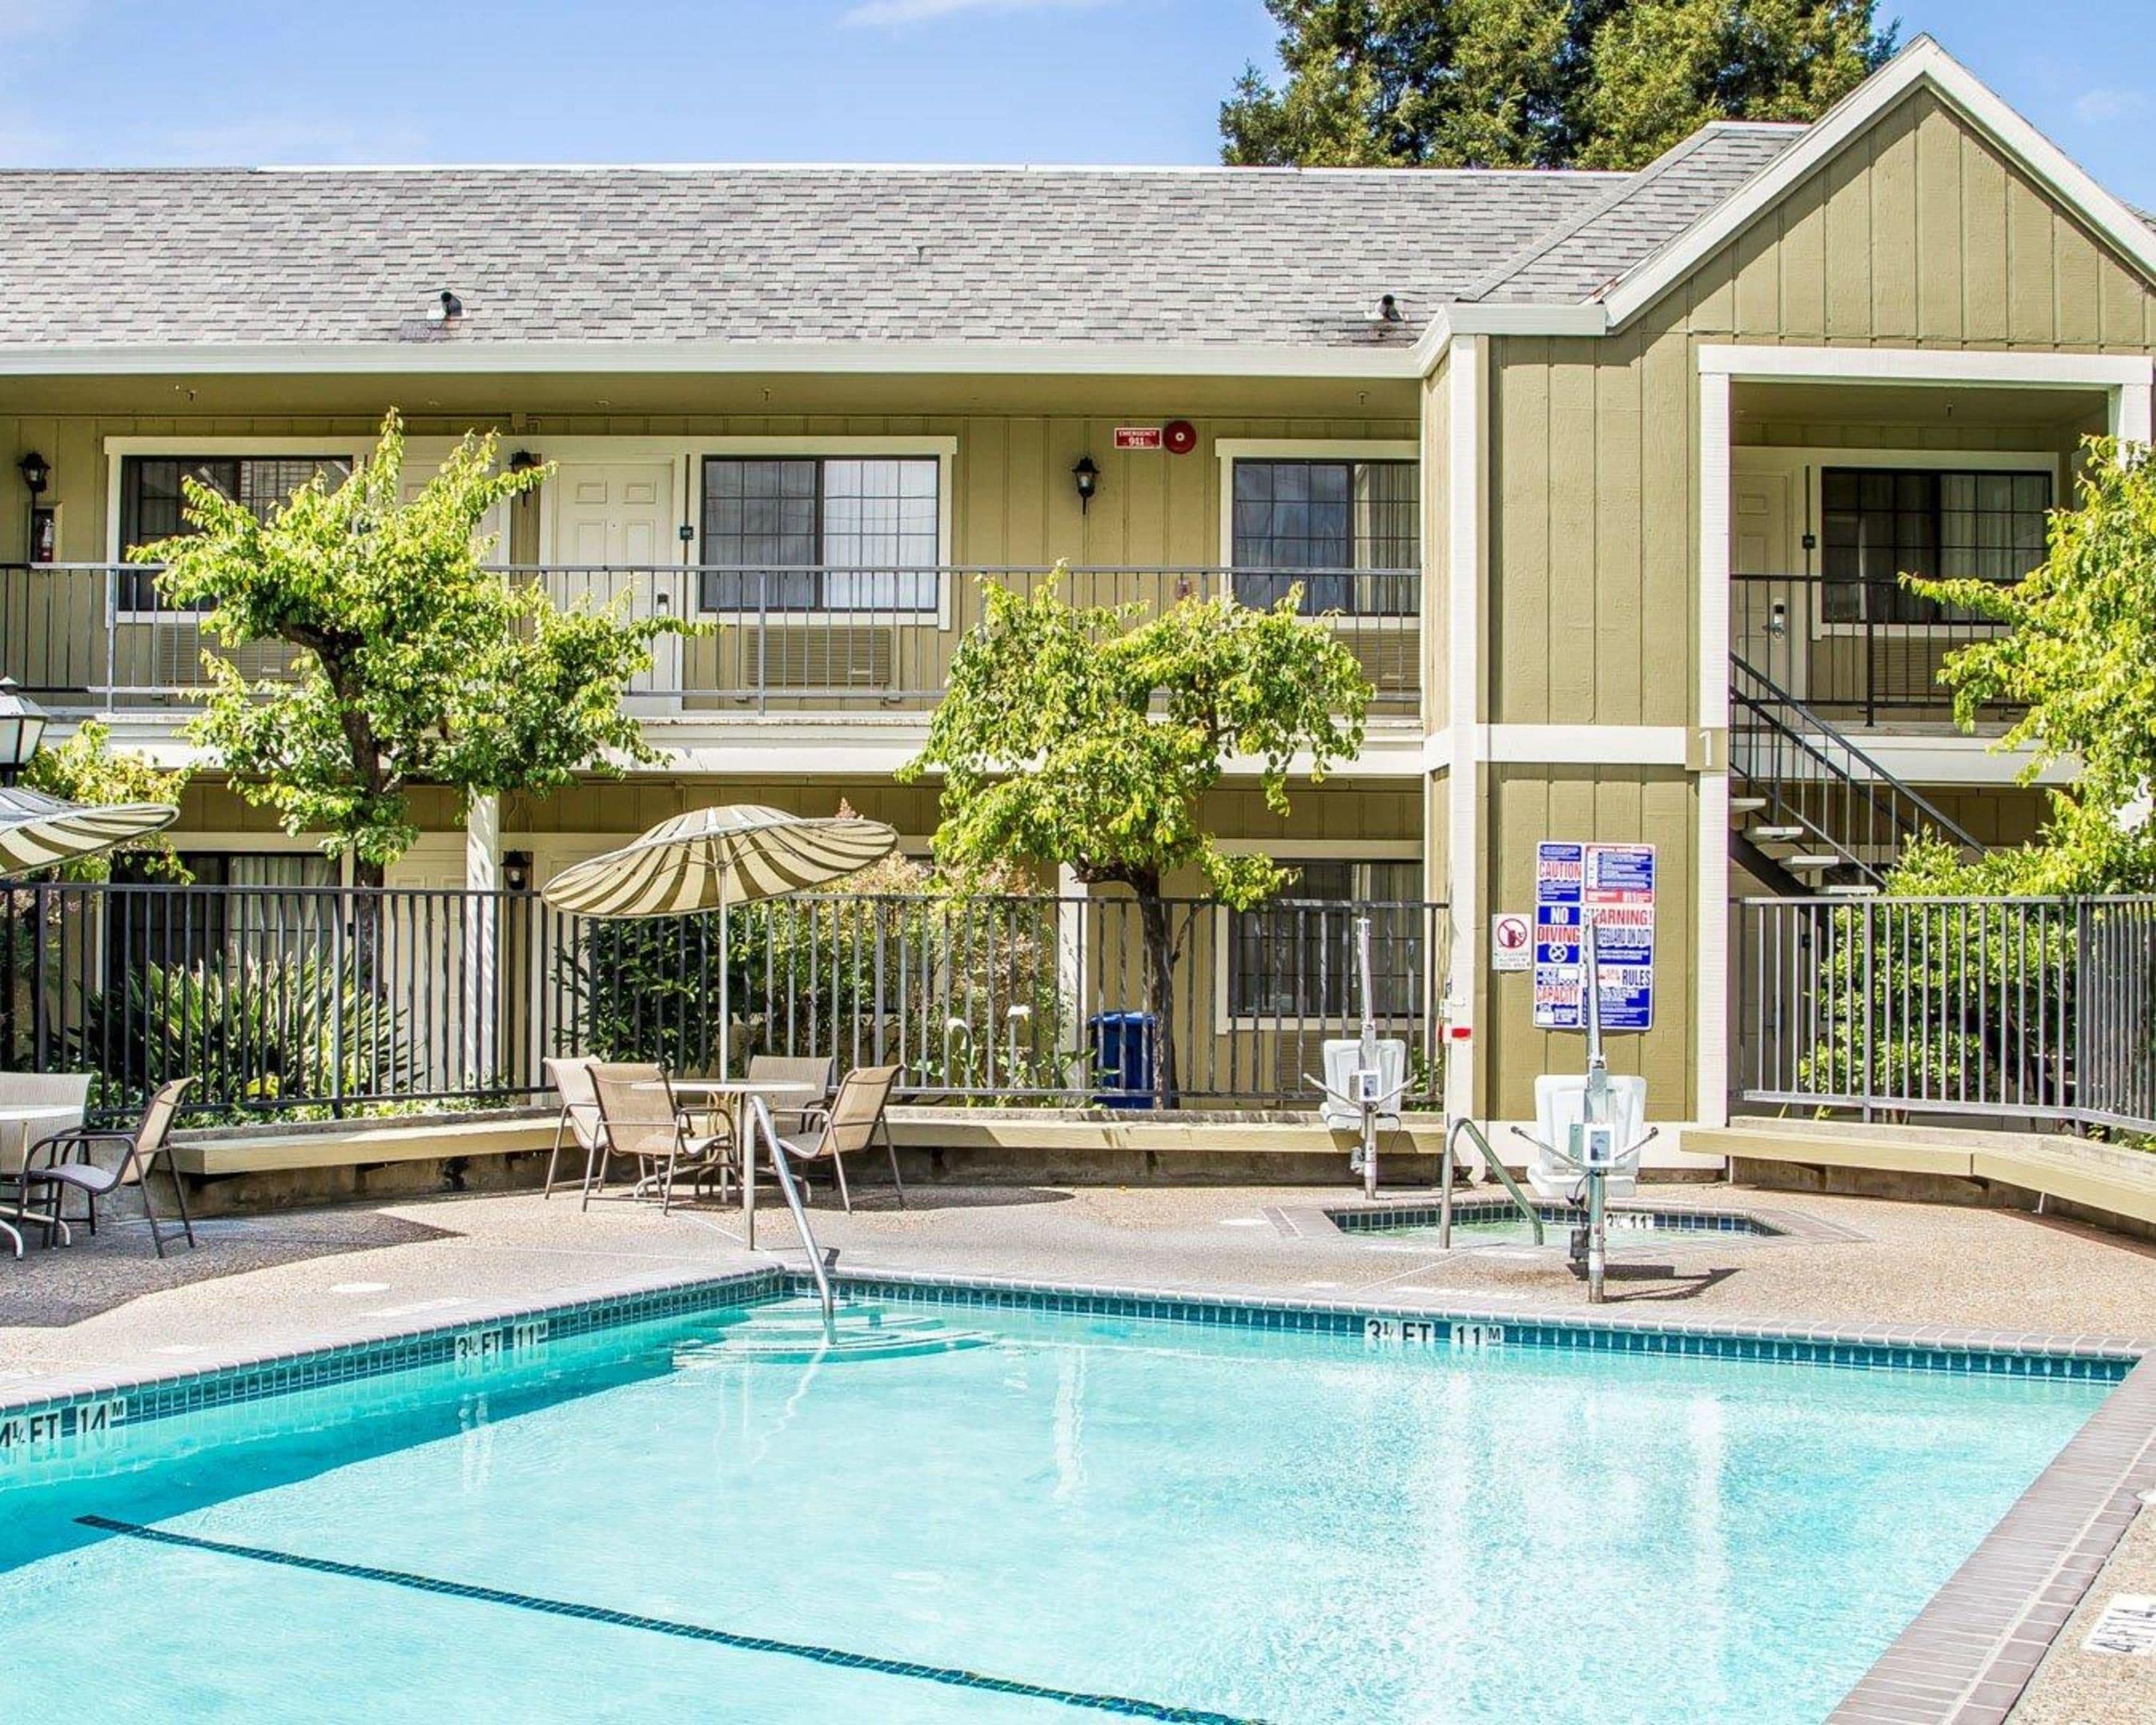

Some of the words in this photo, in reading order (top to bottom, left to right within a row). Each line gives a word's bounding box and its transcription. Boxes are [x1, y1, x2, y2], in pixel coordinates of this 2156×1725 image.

[1699, 730, 1712, 767] 1
[1538, 862, 1582, 879] CAUTION
[1550, 906, 1569, 924] NO
[1537, 926, 1581, 943] DIVING
[1622, 969, 1651, 986] RULES
[1537, 987, 1579, 1003] CAPACITY
[1402, 1321, 1432, 1342] FT
[481, 1330, 502, 1355] FT
[30, 1413, 59, 1443] FT
